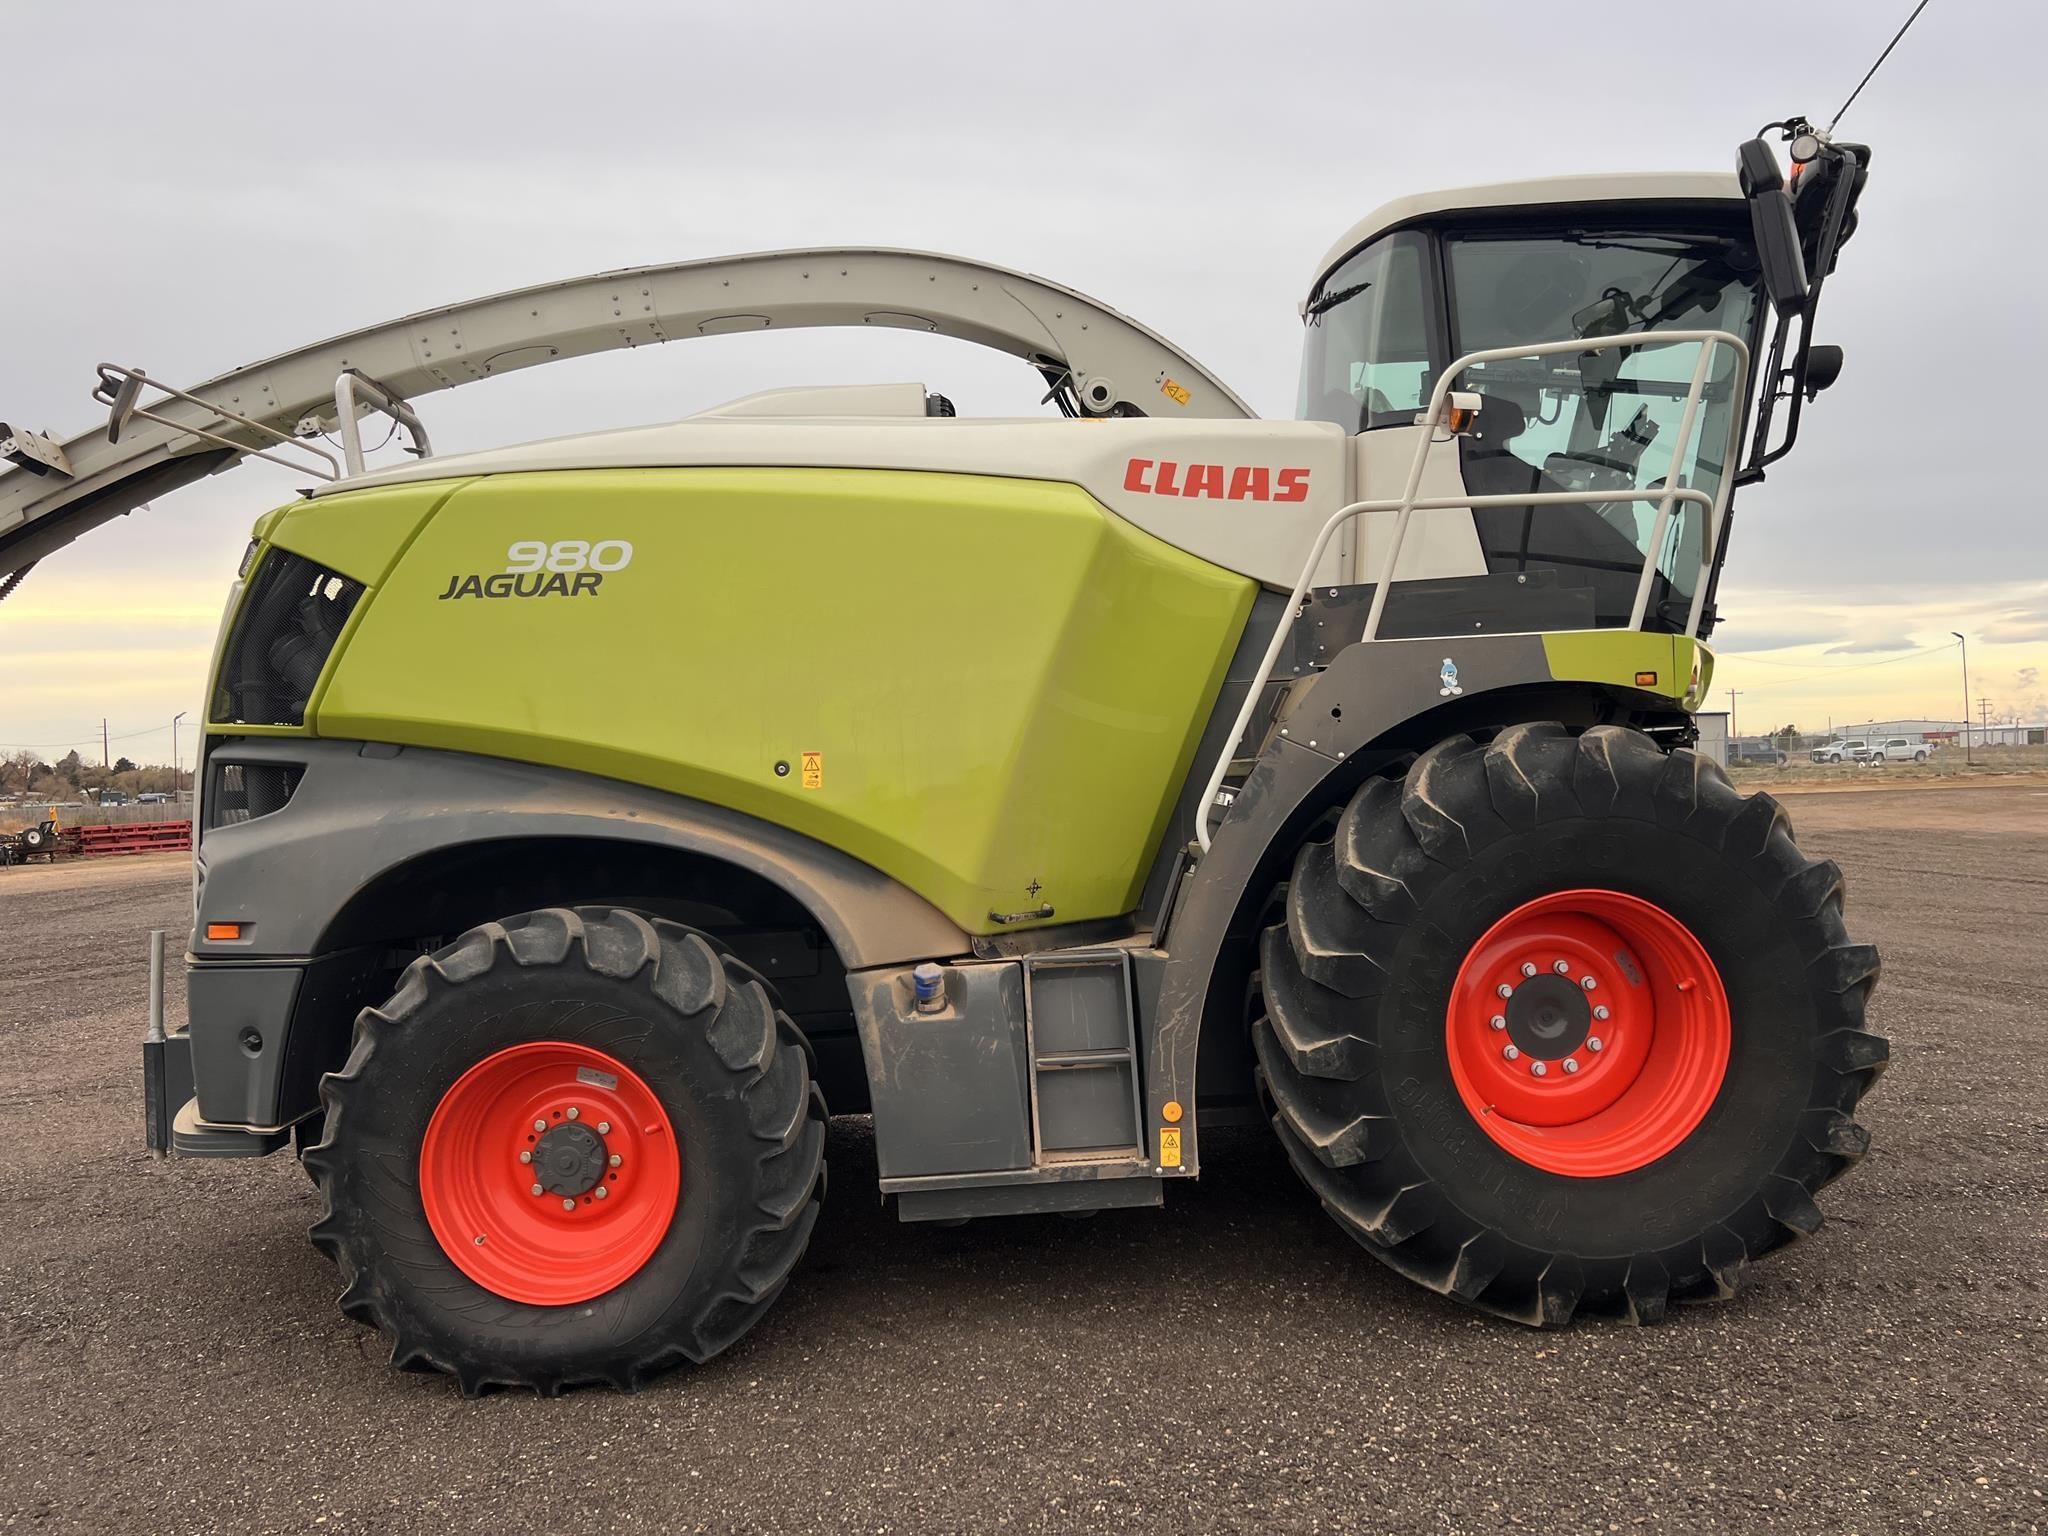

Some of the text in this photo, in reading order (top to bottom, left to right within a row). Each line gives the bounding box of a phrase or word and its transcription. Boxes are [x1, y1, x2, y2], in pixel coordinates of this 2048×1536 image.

[1123, 458, 1311, 502] CLAAS
[505, 540, 633, 573] 980
[438, 572, 603, 600] JAGUAR
